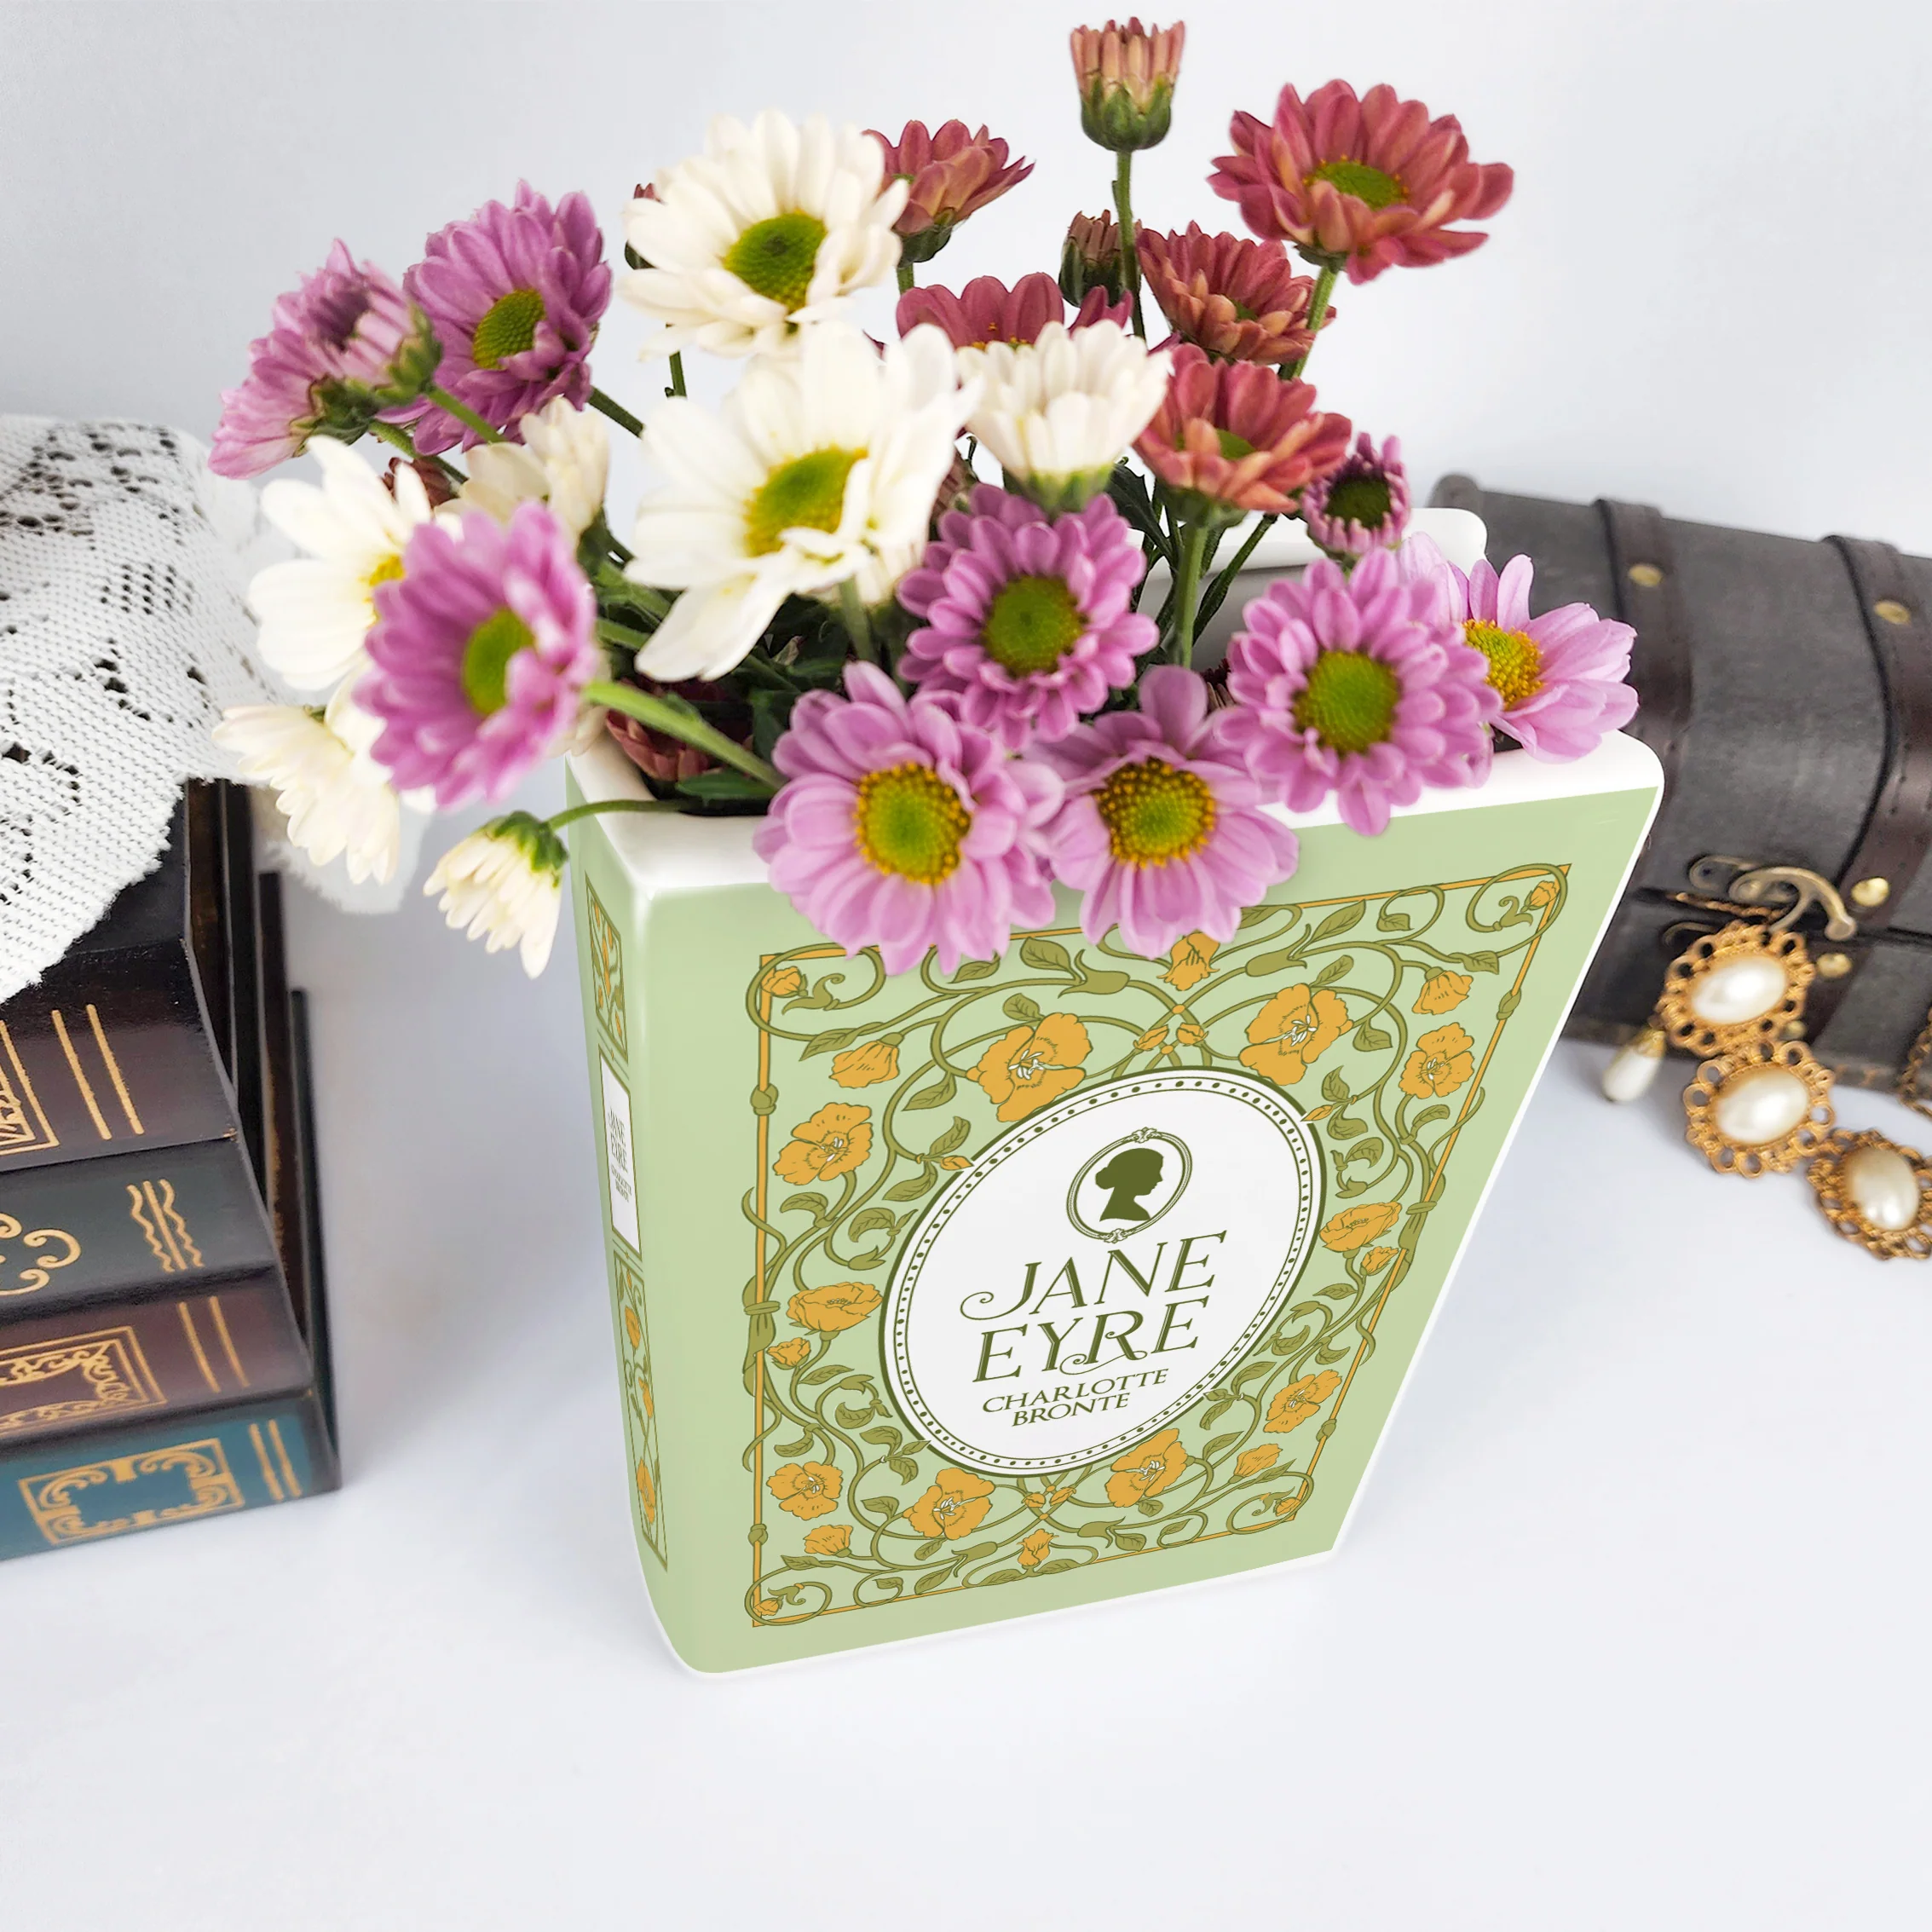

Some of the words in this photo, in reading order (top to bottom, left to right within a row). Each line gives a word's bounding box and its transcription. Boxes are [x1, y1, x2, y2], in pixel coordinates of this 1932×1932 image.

[960, 1231, 1227, 1320] JANE
[972, 1295, 1210, 1383] EYRE
[983, 1369, 1169, 1413] CHARLOTTE
[1012, 1393, 1130, 1427] BRONTE
